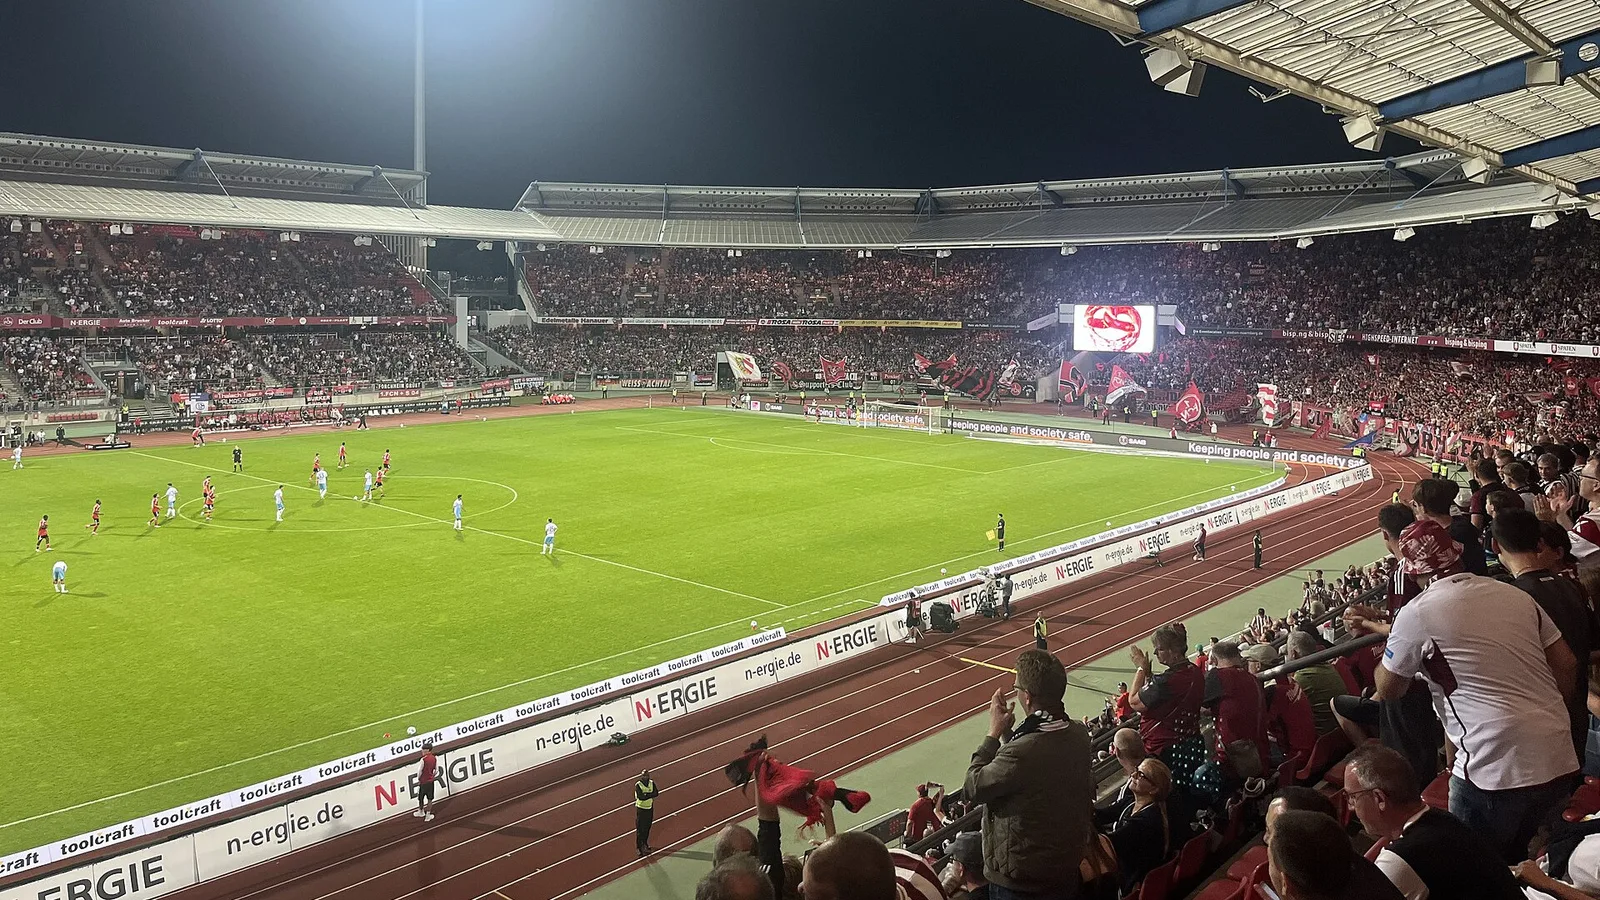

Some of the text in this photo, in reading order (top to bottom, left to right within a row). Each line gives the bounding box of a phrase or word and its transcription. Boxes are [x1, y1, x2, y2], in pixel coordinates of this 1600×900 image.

[1361, 333, 1418, 345] HIGHSPEED-INTERNET
[947, 418, 979, 432] Keeping
[980, 422, 1008, 434] people
[1010, 424, 1028, 435] and
[1030, 427, 1066, 440] society
[1128, 438, 1147, 446] SAAB
[1188, 442, 1231, 458] Keeping
[1232, 448, 1269, 462] people
[1273, 448, 1298, 462] and
[1300, 452, 1345, 468] society
[944, 575, 966, 587] toolcraft
[1014, 571, 1048, 591] n-ergie.de
[751, 629, 782, 646] toolcraft
[711, 641, 744, 658] toolcraft
[668, 654, 703, 672] toolcraft
[744, 650, 801, 681] n-ergie.de
[621, 668, 660, 686] toolcraft
[570, 681, 612, 701] toolcraft
[516, 697, 560, 718] toolcraft
[456, 713, 504, 736] toolcraft
[536, 713, 615, 751] n-ergie.de
[390, 732, 443, 756] toolcraft
[319, 752, 376, 778] toolcraft
[240, 774, 303, 802] toolcraft
[153, 799, 222, 828] toolcraft
[61, 824, 135, 855] toolcraft
[226, 802, 344, 855] n-ergie.de
[0, 852, 40, 874] craft
